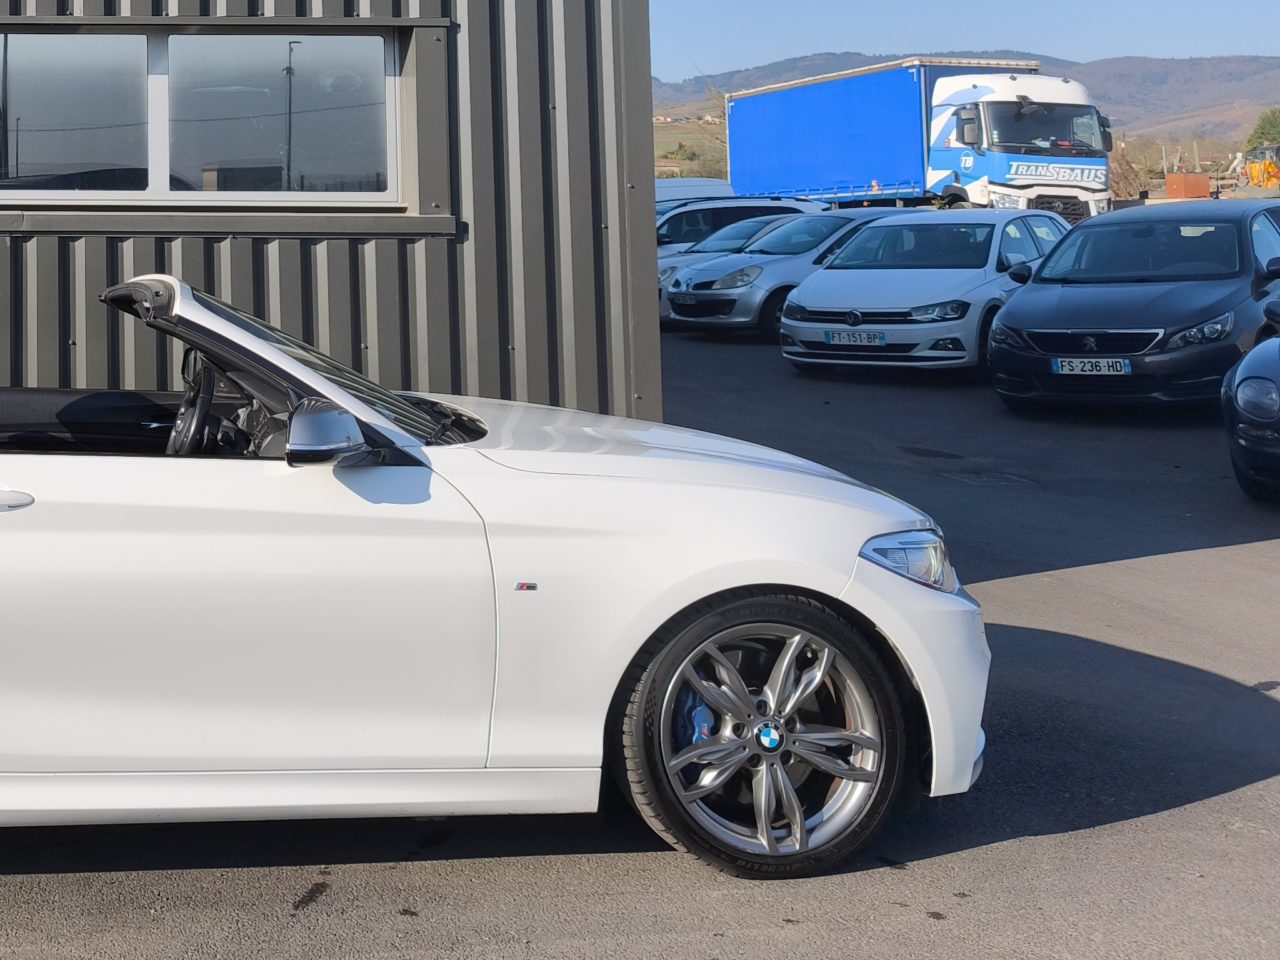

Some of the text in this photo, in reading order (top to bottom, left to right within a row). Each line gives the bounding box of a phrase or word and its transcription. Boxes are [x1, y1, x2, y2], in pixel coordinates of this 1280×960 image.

[960, 156, 974, 168] TB
[831, 332, 878, 344] FT-151-BP
[1060, 360, 1123, 373] FS-236-HD
